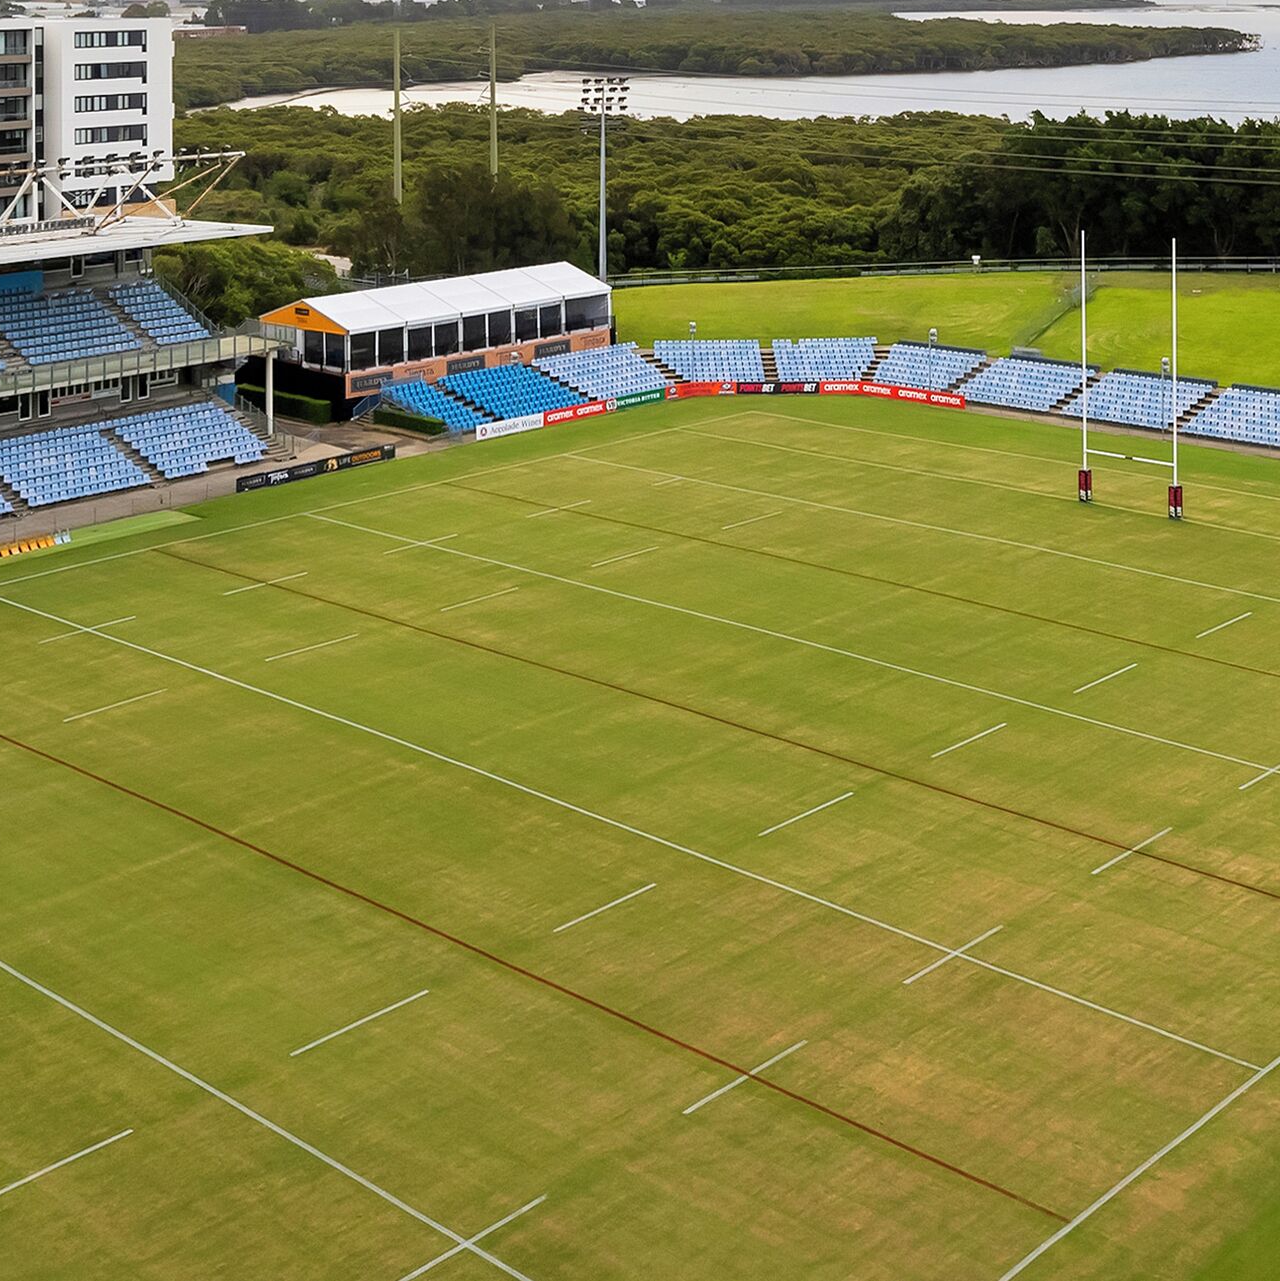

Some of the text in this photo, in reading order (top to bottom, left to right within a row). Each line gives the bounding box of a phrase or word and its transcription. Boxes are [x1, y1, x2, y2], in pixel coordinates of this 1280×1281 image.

[824, 383, 892, 395] aramex aramex
[898, 389, 961, 405] aramex aramex
[617, 396, 641, 407] VICTORIA
[641, 393, 660, 402] BITTER
[547, 403, 603, 422] aramex aramex
[490, 417, 542, 435] Accolade Wines
[339, 449, 381, 465] LIFE OUTDOORS
